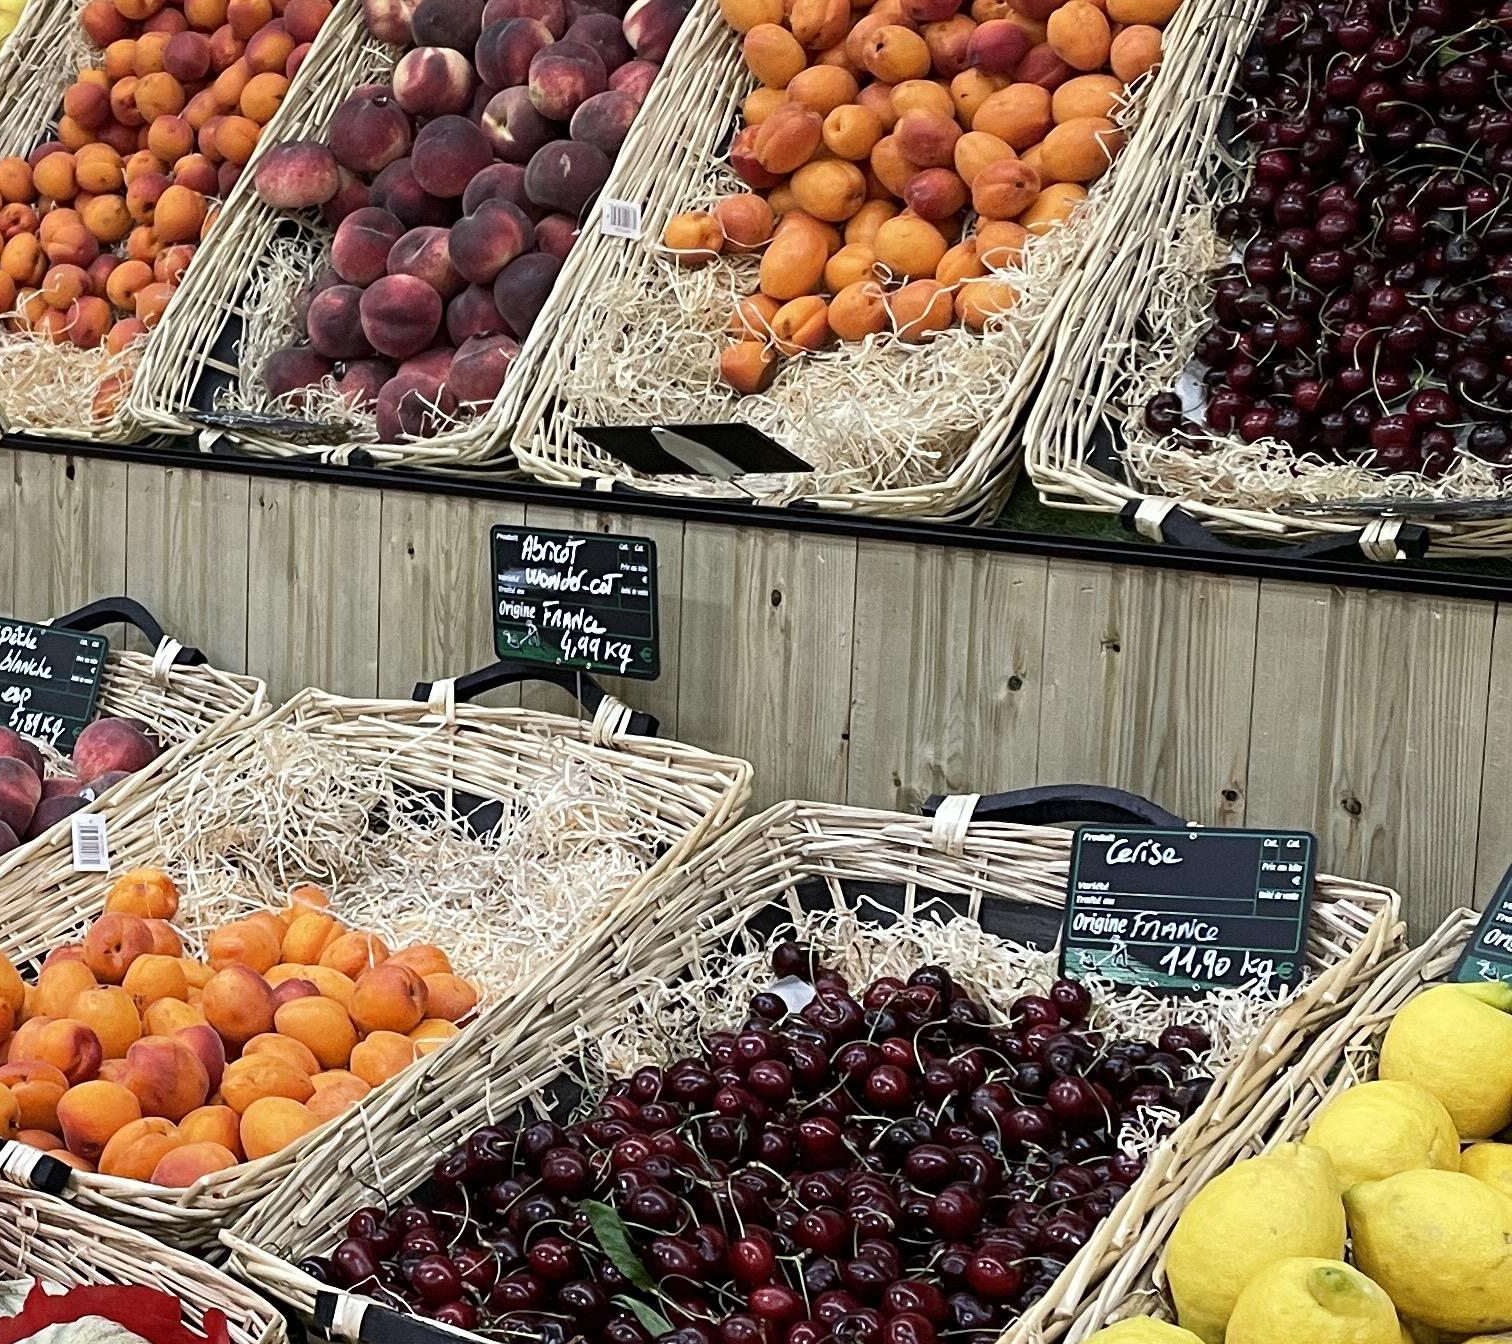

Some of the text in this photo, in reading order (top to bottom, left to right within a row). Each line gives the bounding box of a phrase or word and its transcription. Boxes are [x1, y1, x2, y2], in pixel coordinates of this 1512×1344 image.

[499, 600, 536, 619] Origine
[561, 630, 601, 660] 4,99
[1083, 833, 1115, 842] Produit
[1106, 838, 1183, 865] Cerise
[1262, 863, 1276, 871] Prix
[1074, 913, 1128, 935] Origine
[1160, 946, 1231, 979] 11,90
